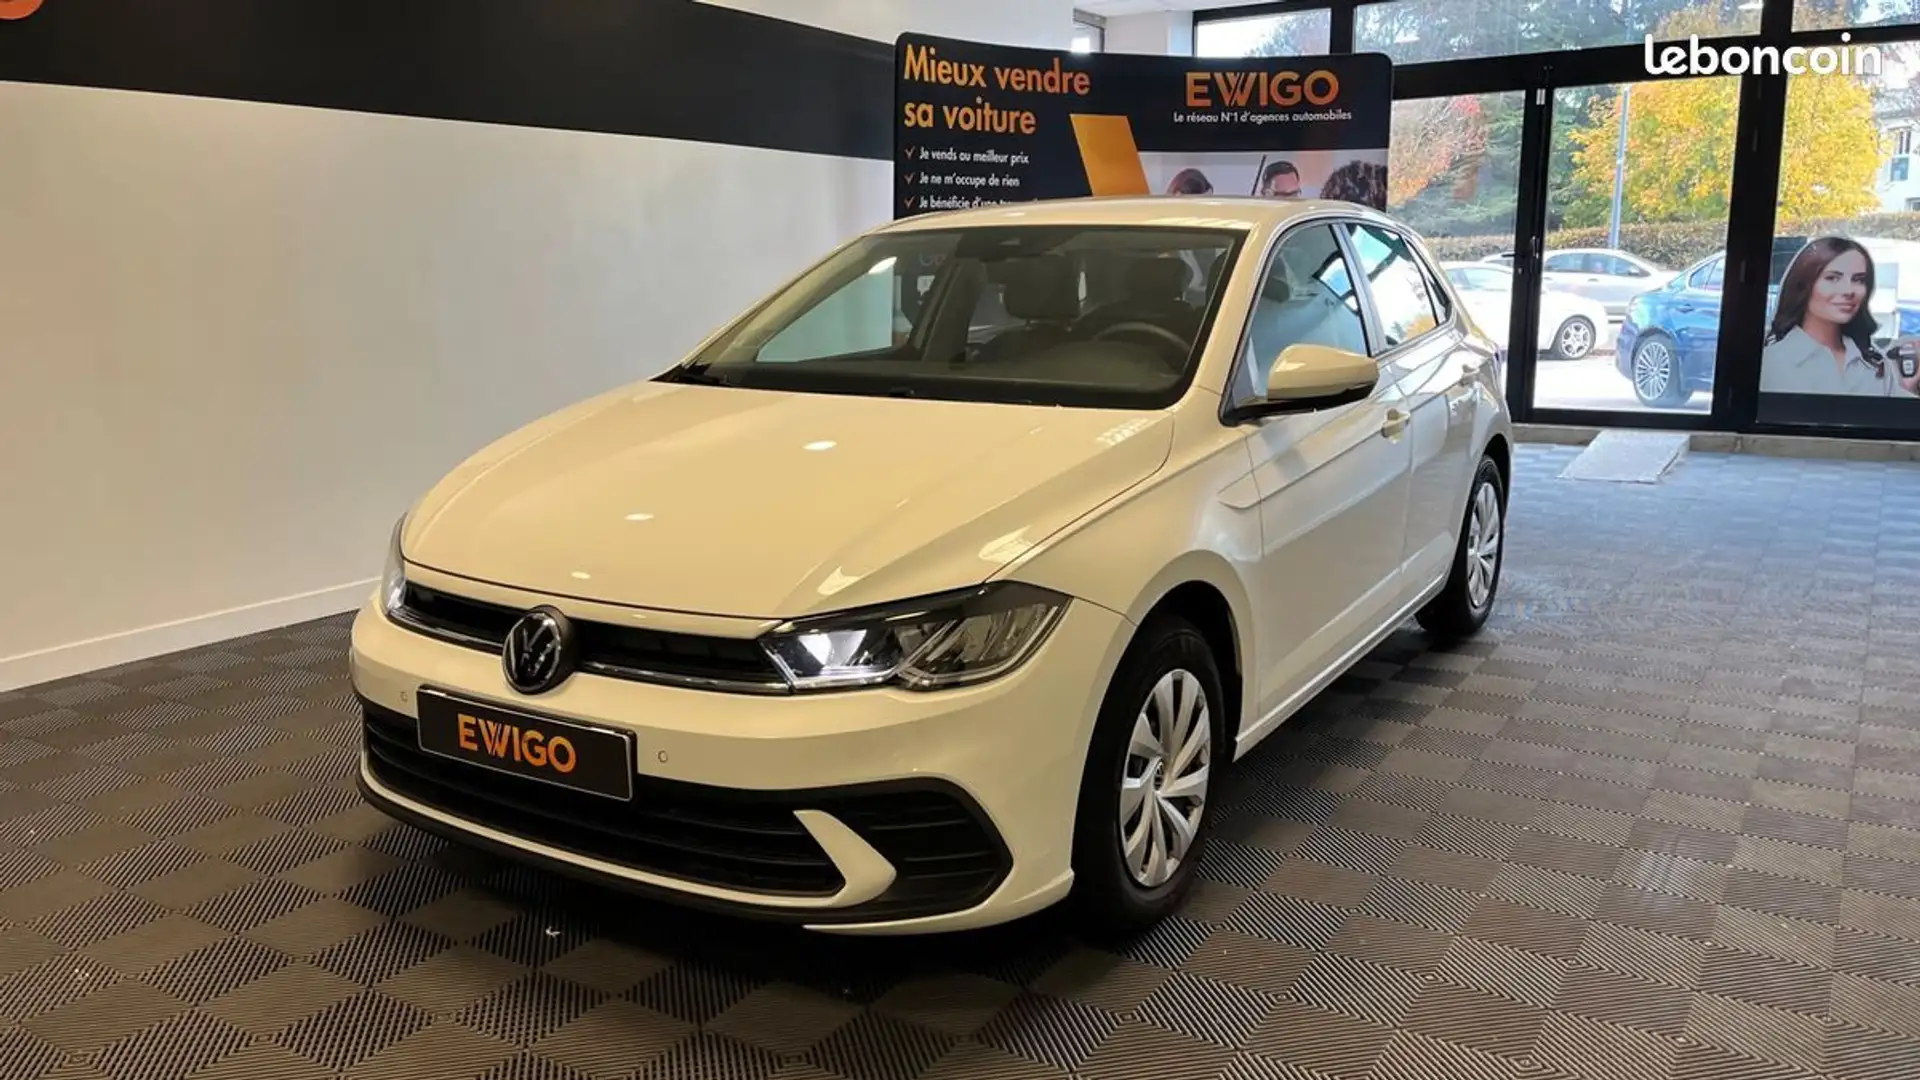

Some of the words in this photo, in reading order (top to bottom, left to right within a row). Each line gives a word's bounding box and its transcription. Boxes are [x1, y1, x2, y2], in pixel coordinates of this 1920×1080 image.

[904, 44, 987, 88] Mieux
[994, 57, 1091, 95] vendre
[1186, 70, 1339, 107] EWIGO
[904, 102, 933, 127] sa
[942, 96, 1037, 134] voiture
[1173, 112, 1184, 122] Le
[1187, 111, 1218, 122] réseau
[1240, 111, 1289, 125] d'agences
[1292, 109, 1352, 121] automobiles
[919, 147, 929, 160] Je
[931, 148, 957, 161] vends
[973, 149, 1008, 163] meilleur
[1010, 152, 1029, 167] prix
[919, 172, 929, 185] Je
[930, 175, 942, 185] ne
[944, 172, 986, 188] m'occupe
[988, 173, 1000, 187] de
[1002, 174, 1021, 187] rien
[919, 197, 928, 209] Je
[930, 195, 970, 210] bénéficie
[457, 713, 577, 774] EWIGO
